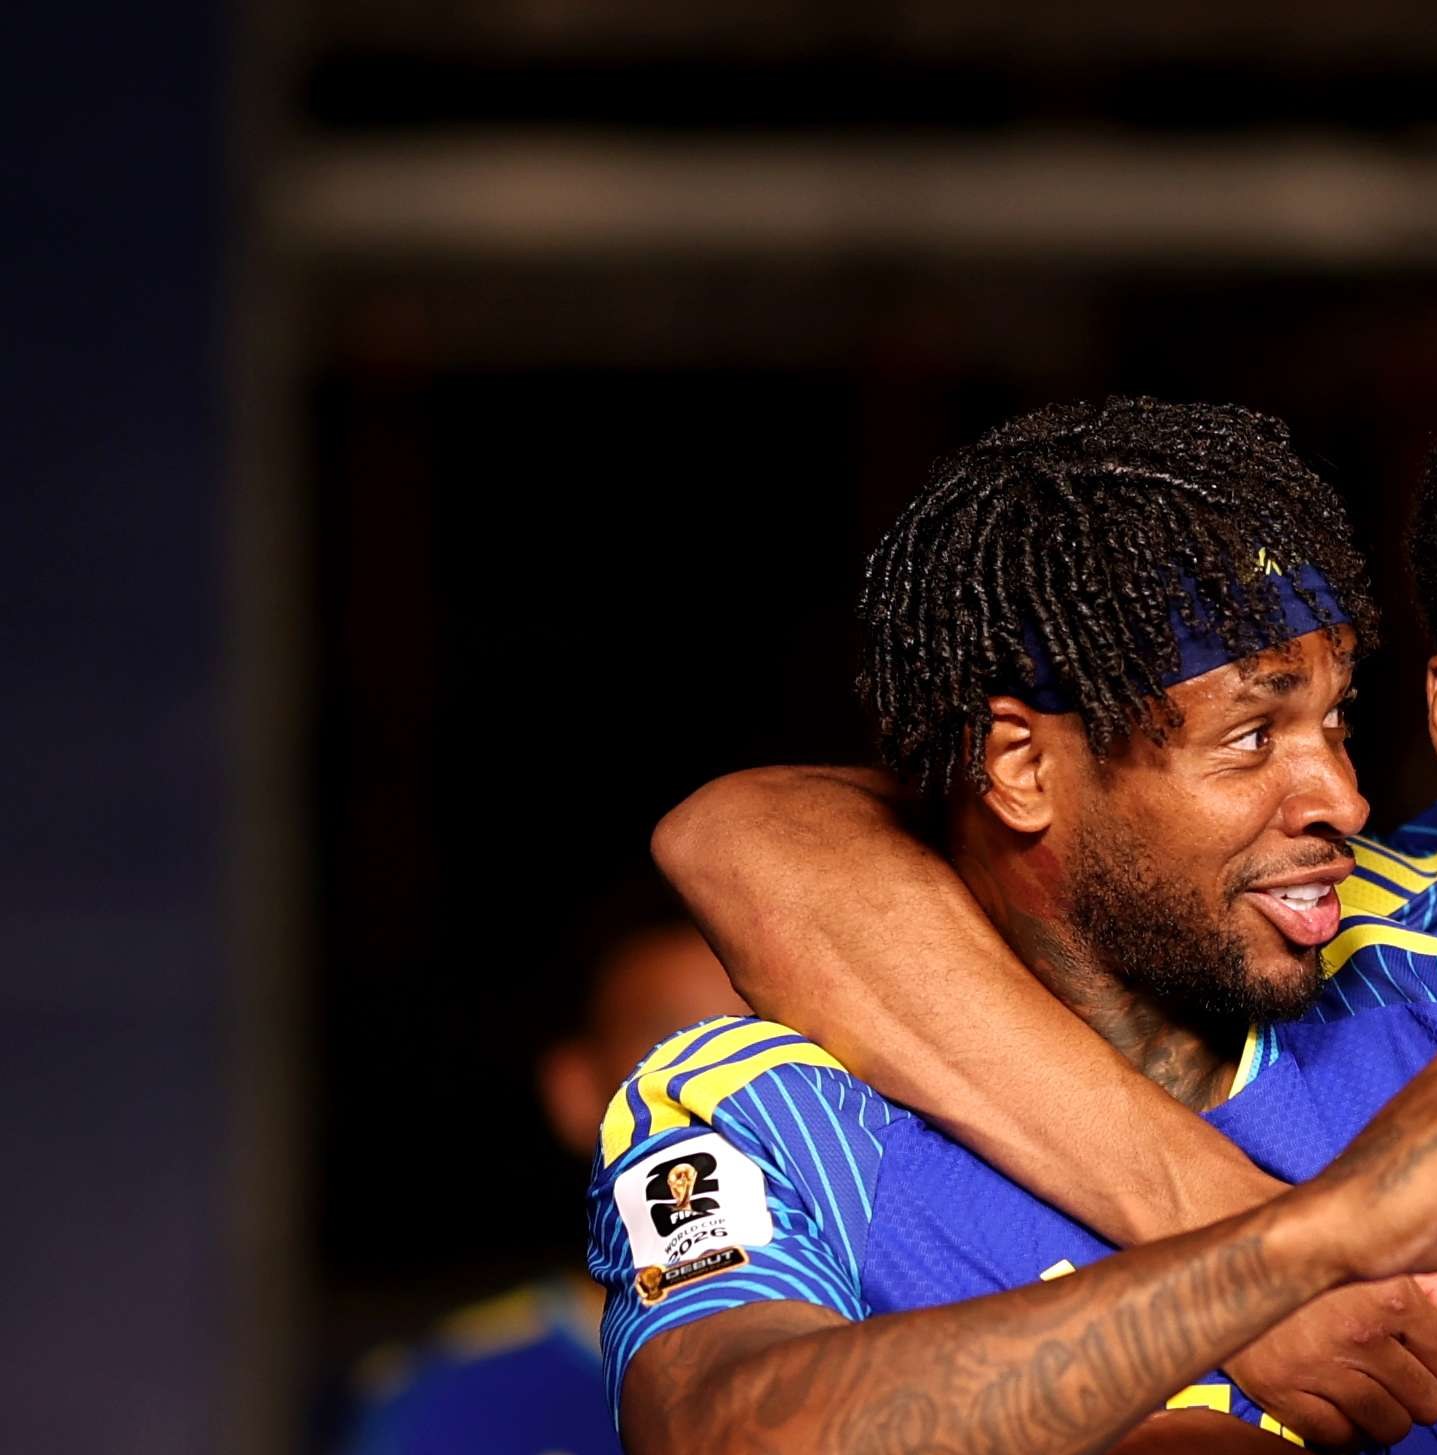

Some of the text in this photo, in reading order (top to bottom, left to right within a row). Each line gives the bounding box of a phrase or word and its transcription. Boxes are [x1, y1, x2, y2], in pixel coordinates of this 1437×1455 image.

[664, 1225, 698, 1254] WORLD
[668, 1227, 728, 1265] 2026
[665, 1249, 734, 1281] DEBUT
